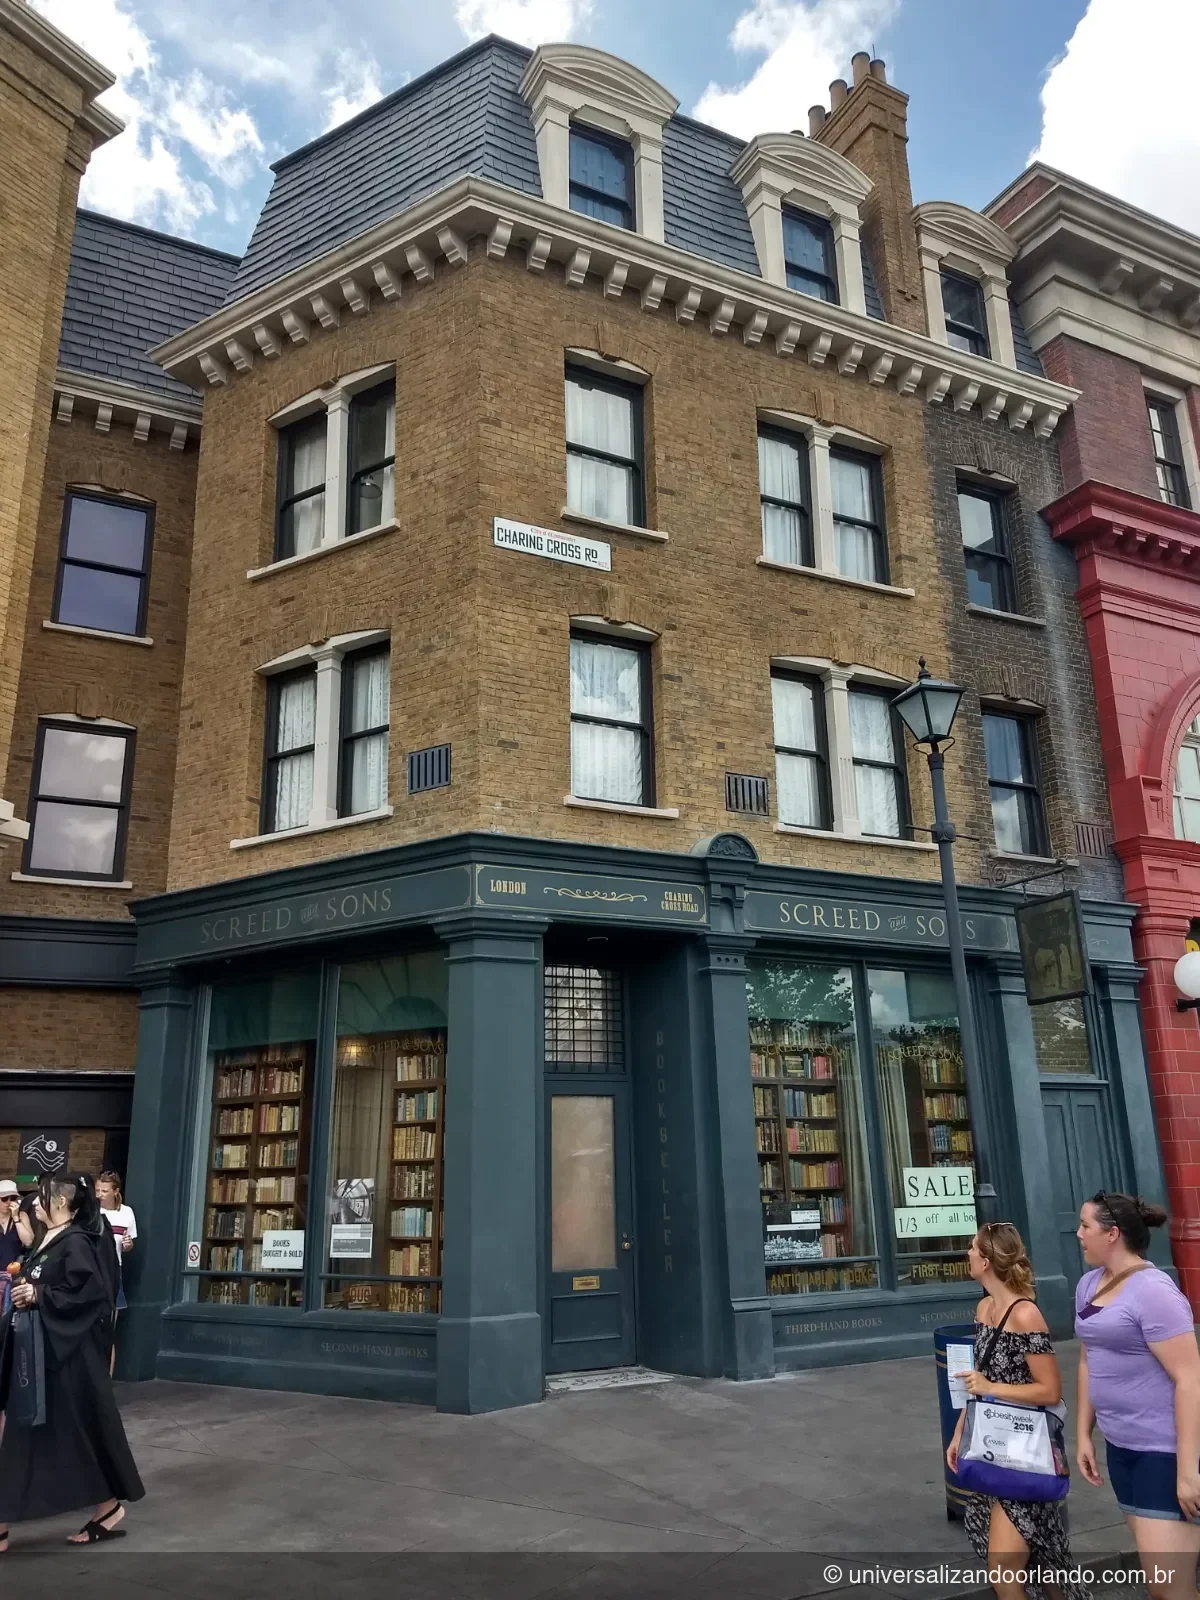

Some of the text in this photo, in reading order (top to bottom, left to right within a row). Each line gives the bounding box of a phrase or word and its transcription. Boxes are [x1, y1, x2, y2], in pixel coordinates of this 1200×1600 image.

[497, 527, 543, 551] CHARING
[547, 538, 581, 560] CROSS
[490, 880, 527, 895] LONDON
[664, 891, 693, 903] CHARING
[661, 900, 699, 913] CROSS ROAD
[200, 907, 292, 944] SCREED
[326, 888, 392, 921] SONS
[779, 902, 976, 939] SCREED and SOS
[908, 1175, 971, 1198] SALE
[898, 1217, 918, 1233] 1/3
[925, 1213, 940, 1224] off
[949, 1212, 959, 1223] all
[272, 1239, 291, 1248] BOOKS
[262, 1249, 303, 1258] BOUGHT & SOLD
[912, 1264, 940, 1279] FIRST
[785, 1317, 883, 1335] THIRD-HAND BOOKS
[320, 1342, 429, 1358] SECOND-HAND BOOKS
[989, 1408, 1035, 1424] obesityweek
[1013, 1422, 1034, 1432] 2016
